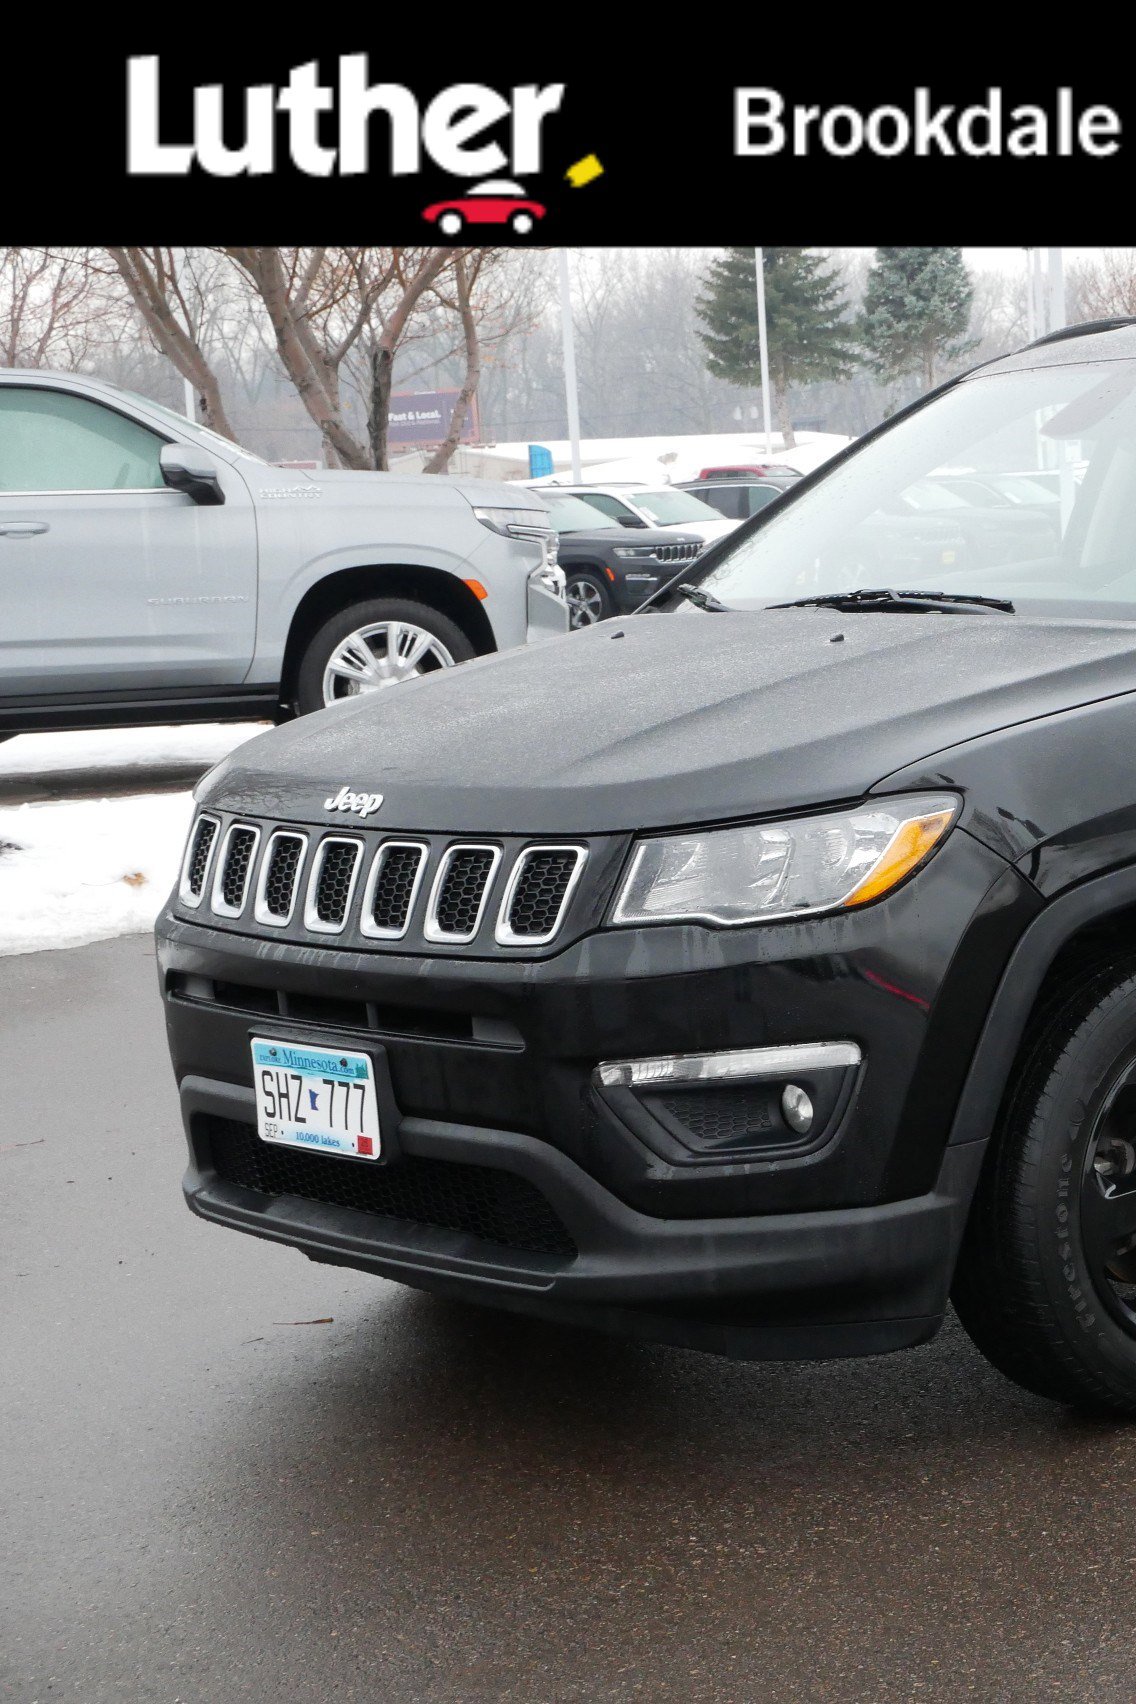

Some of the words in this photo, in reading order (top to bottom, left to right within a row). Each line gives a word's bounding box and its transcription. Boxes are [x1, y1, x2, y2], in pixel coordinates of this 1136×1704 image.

[388, 412, 407, 421] Fast
[407, 411, 415, 420] &
[323, 786, 384, 819] Jeep
[262, 1070, 307, 1124] SHZ
[322, 1078, 366, 1133] 777
[265, 1122, 278, 1138] SEP
[296, 1131, 320, 1144] 10,000
[321, 1135, 340, 1147] lakes
